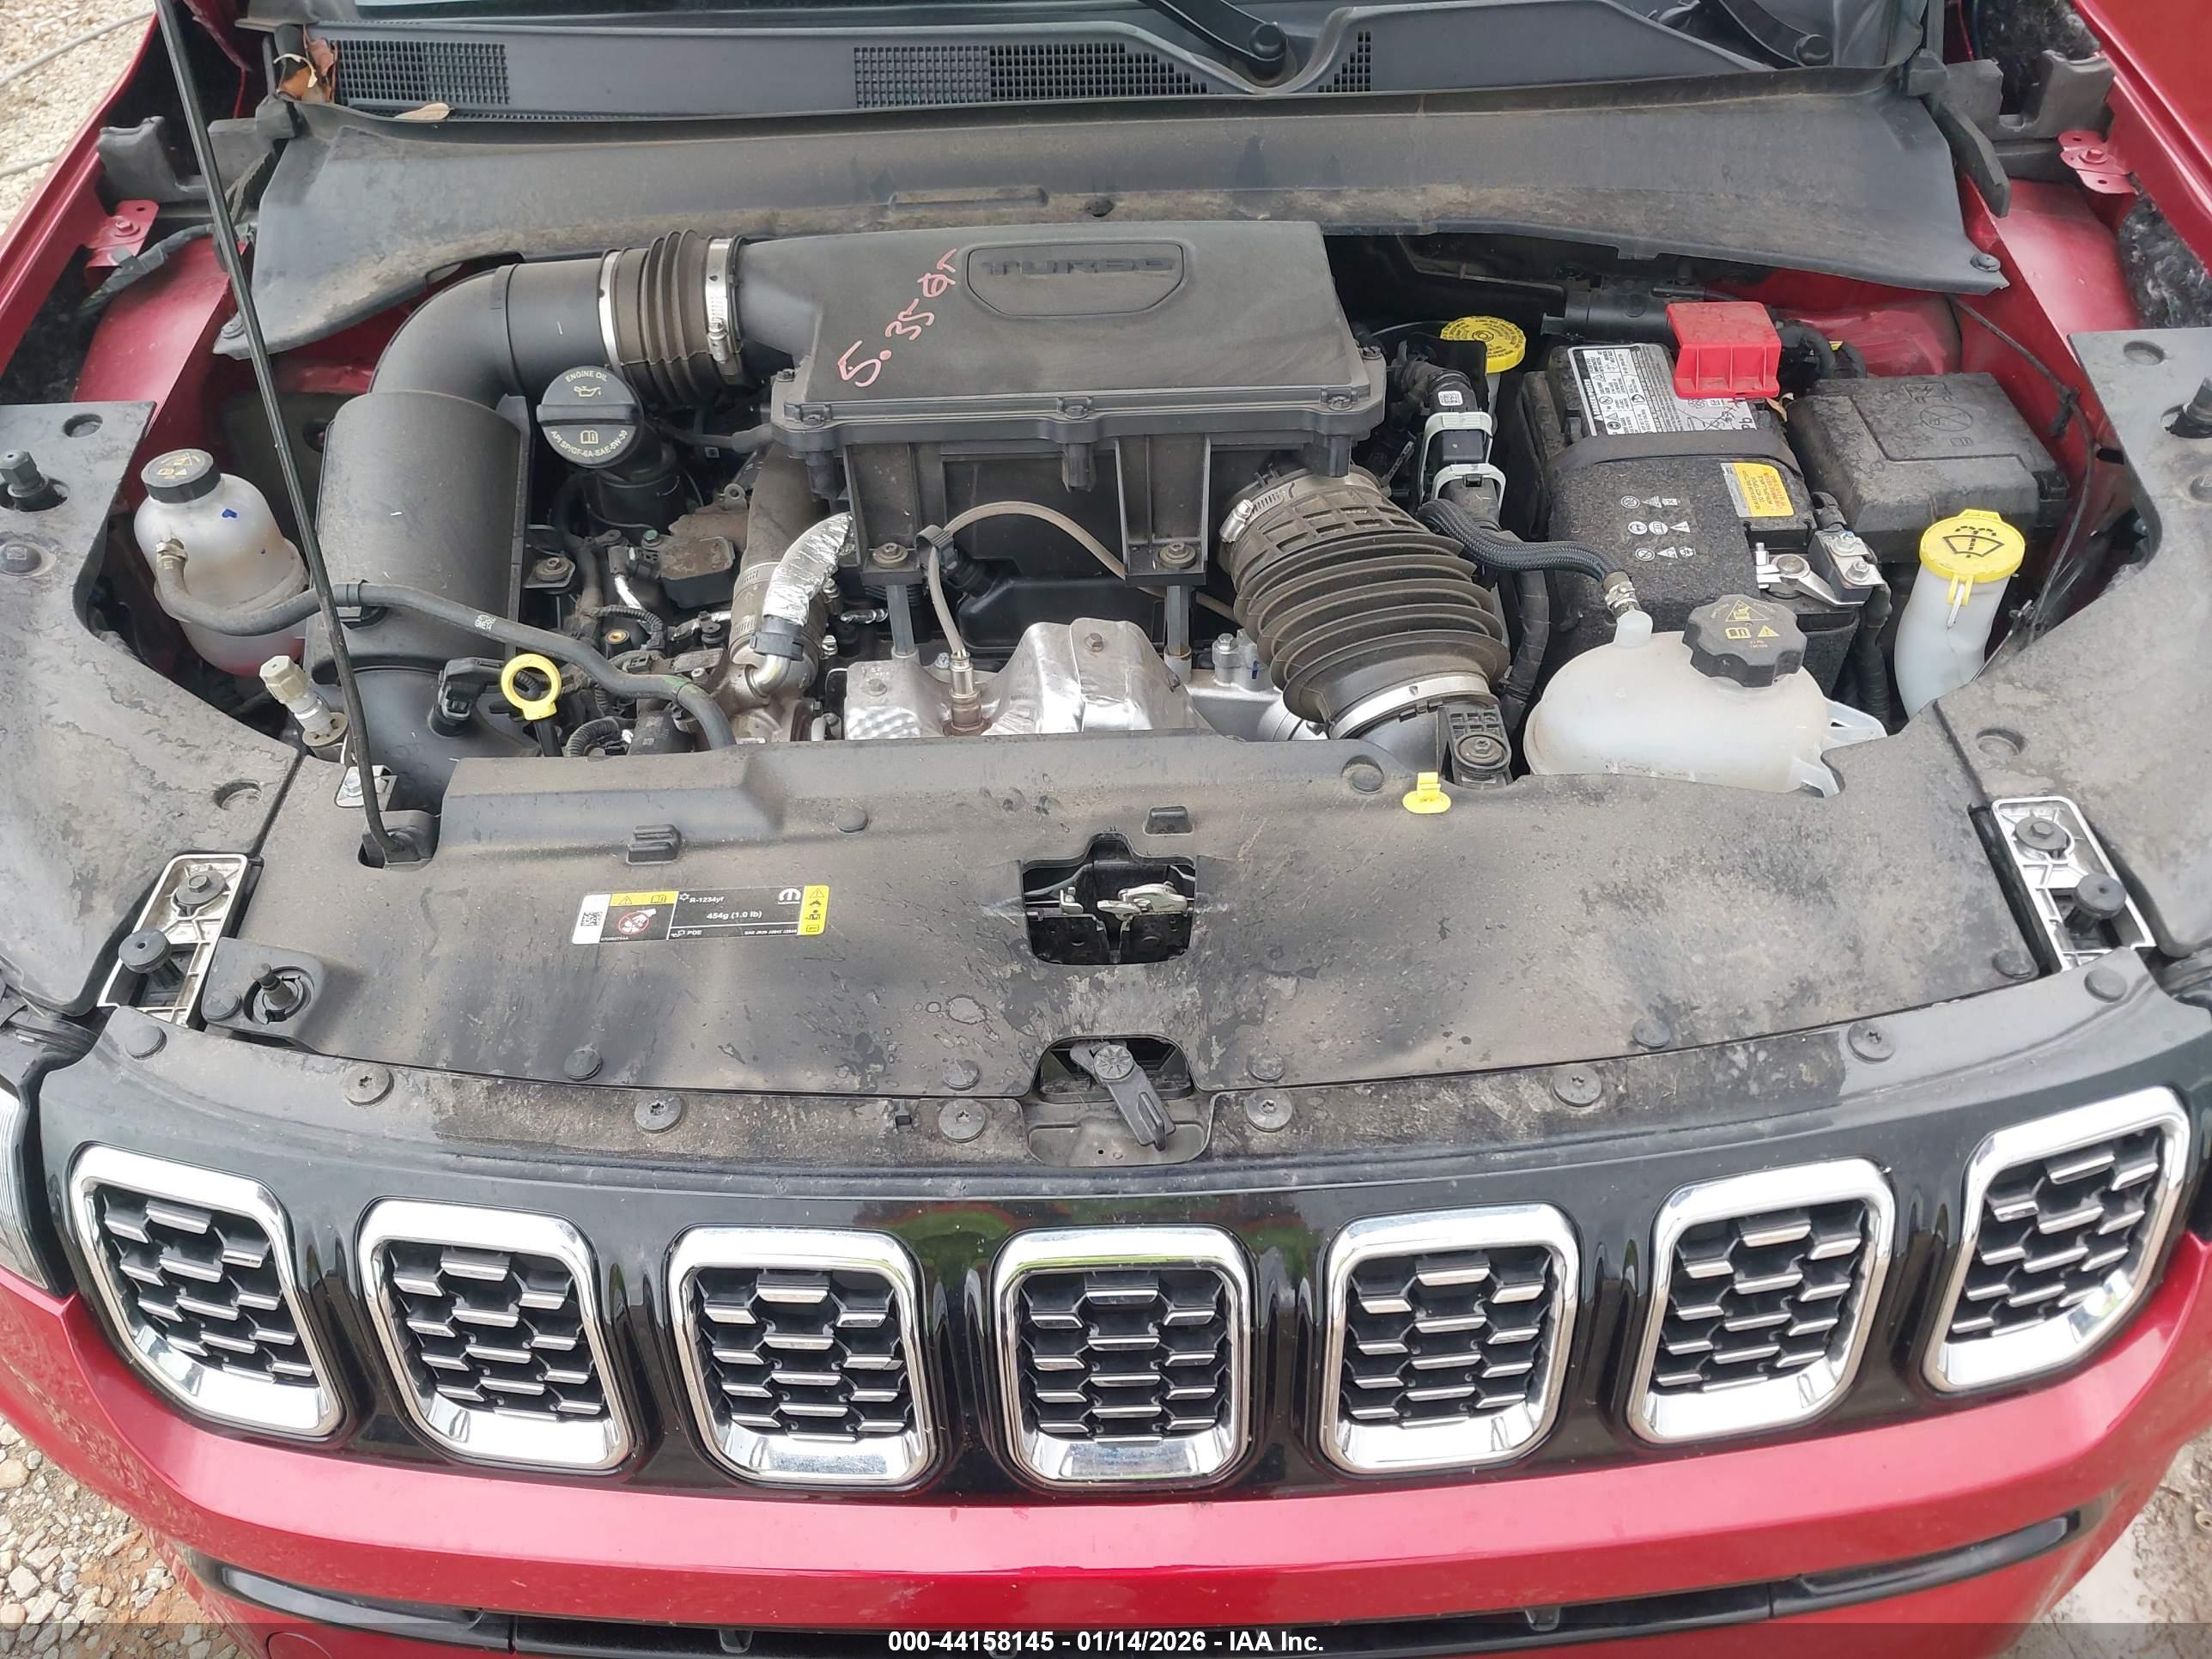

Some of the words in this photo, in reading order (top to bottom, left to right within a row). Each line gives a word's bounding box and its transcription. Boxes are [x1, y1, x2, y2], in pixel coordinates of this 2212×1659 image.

[981, 258, 1174, 276] TURBO
[564, 370, 595, 383] ENGINE
[595, 371, 608, 383] OIL
[550, 430, 563, 444] API
[689, 895, 725, 904] R-1234yf
[707, 911, 729, 921] 454g
[732, 910, 748, 920] (1.0
[750, 909, 763, 919] lb)
